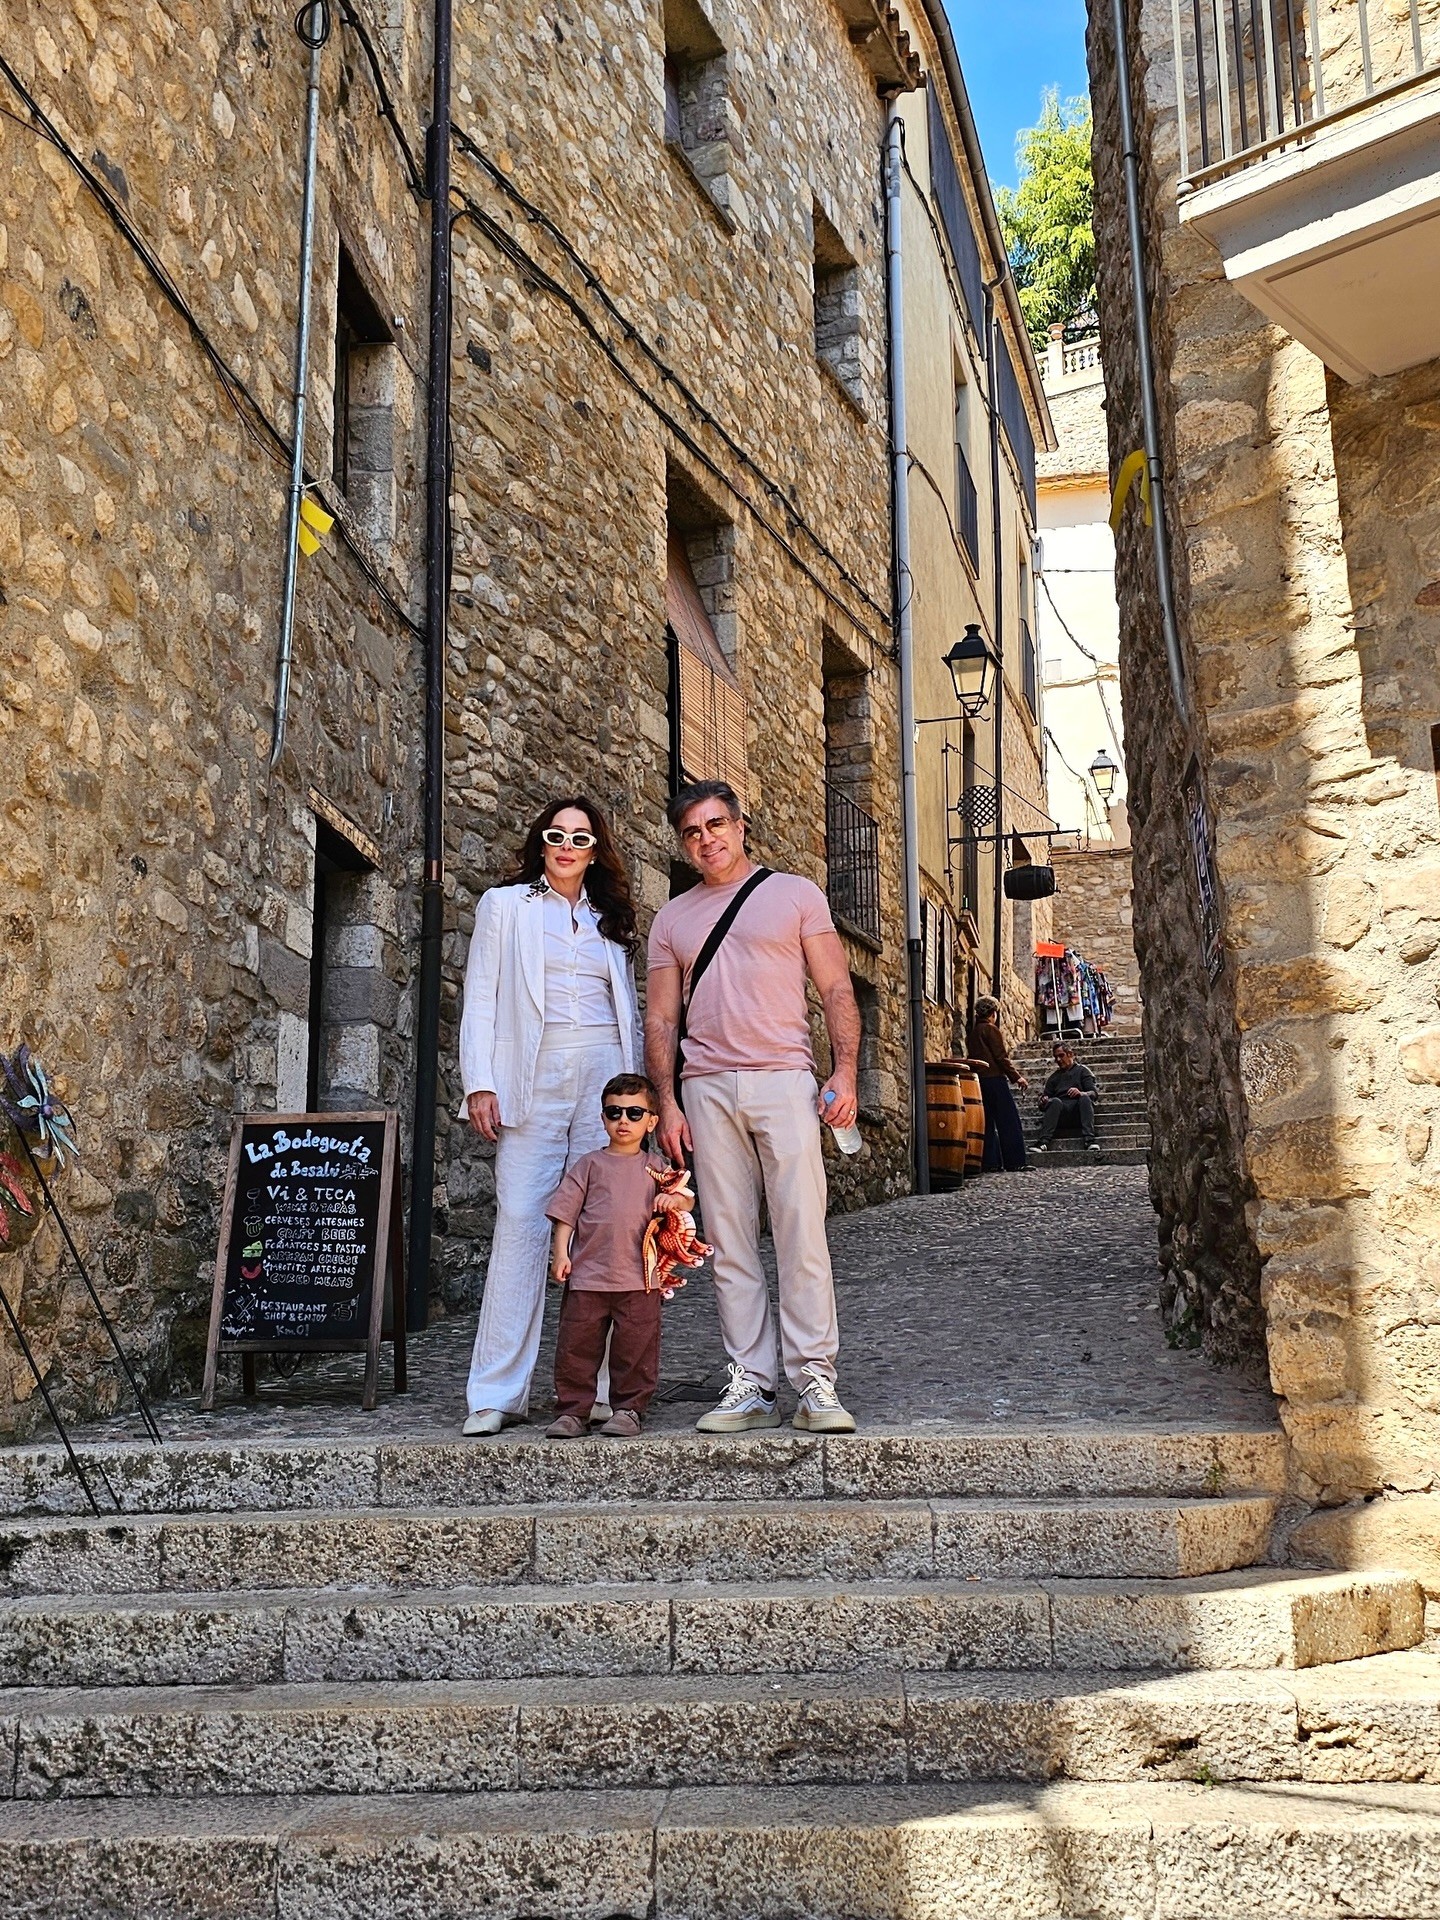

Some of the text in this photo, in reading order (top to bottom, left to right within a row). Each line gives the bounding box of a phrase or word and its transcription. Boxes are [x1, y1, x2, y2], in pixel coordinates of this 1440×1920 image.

[245, 1129, 371, 1164] La Bodegueta
[270, 1160, 340, 1178] de Besalú
[267, 1185, 356, 1201] Vi & TECA
[309, 1202, 320, 1212] &
[264, 1216, 364, 1226] CERVESES ARTESANES
[322, 1228, 356, 1240] BEER
[322, 1244, 332, 1252] DE
[336, 1244, 366, 1254] PASTOR
[310, 1265, 356, 1275] ARTESANS
[270, 1273, 354, 1288] CURED MEATS
[260, 1302, 327, 1312] RESTAURANT
[264, 1312, 327, 1322] SHOP & ENJOY
